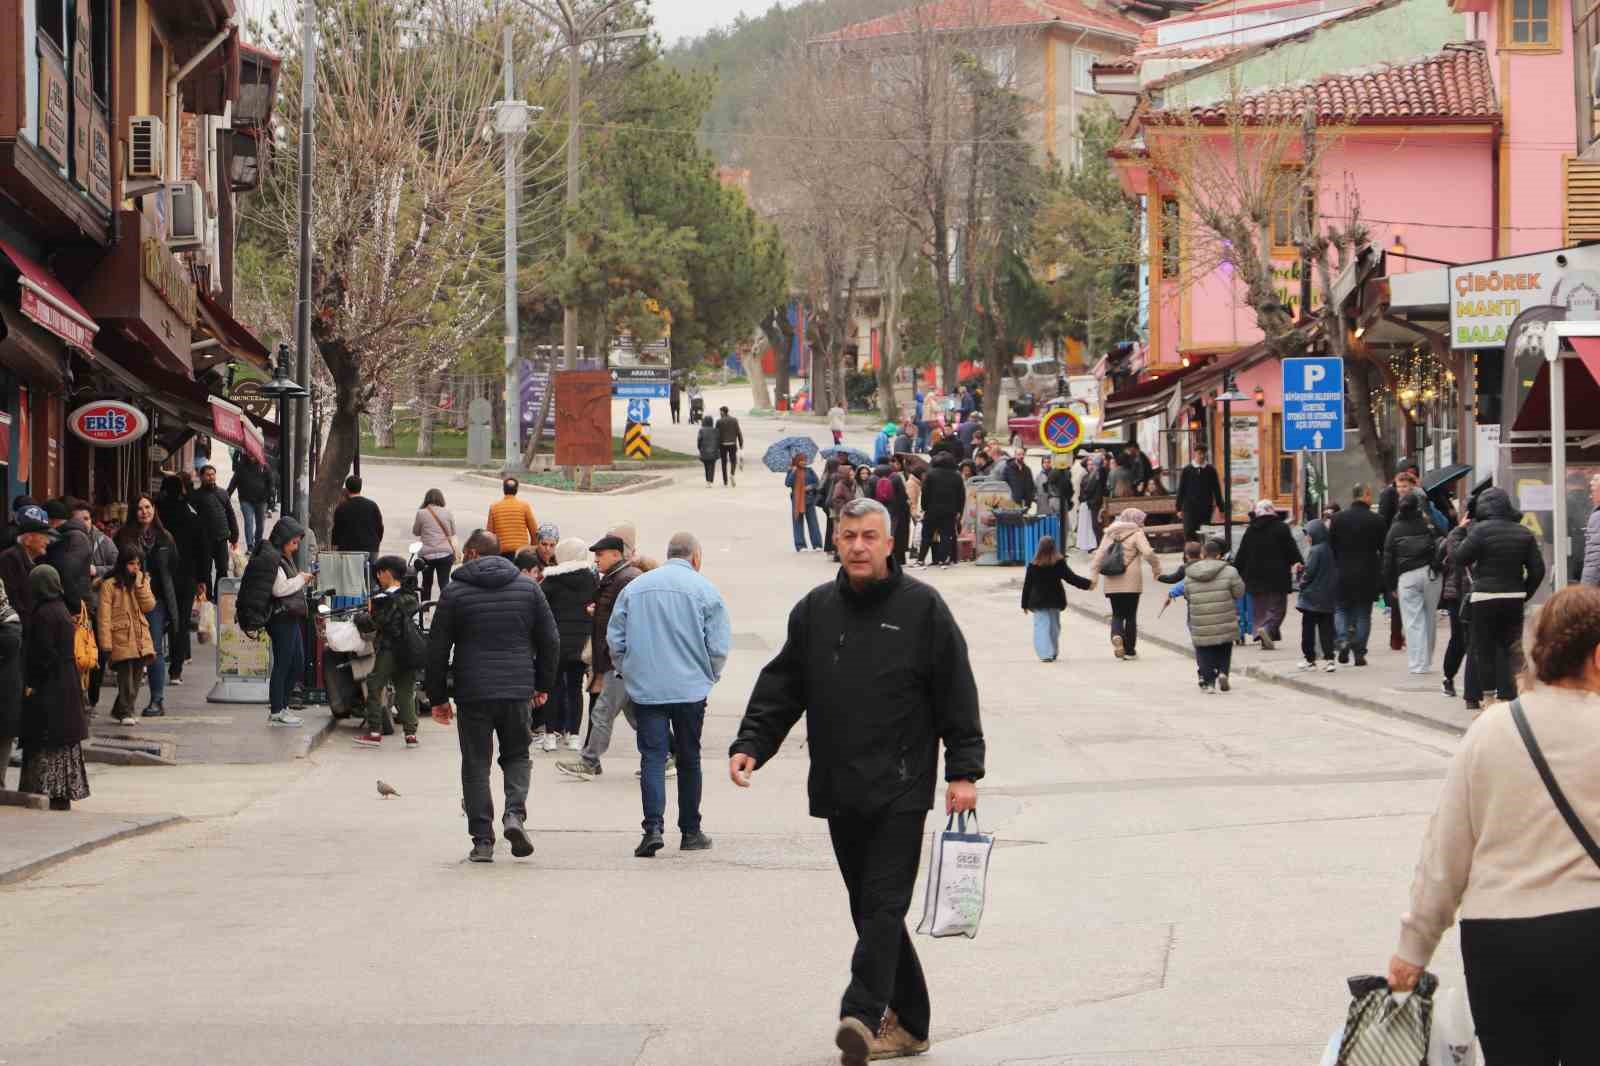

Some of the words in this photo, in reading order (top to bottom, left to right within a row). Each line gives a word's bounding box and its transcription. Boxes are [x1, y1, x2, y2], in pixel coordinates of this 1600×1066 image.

[1456, 299, 1520, 317] MANTI
[1457, 325, 1508, 343] BALA
[1304, 365, 1325, 390] P
[84, 410, 126, 436] ERİŞ
